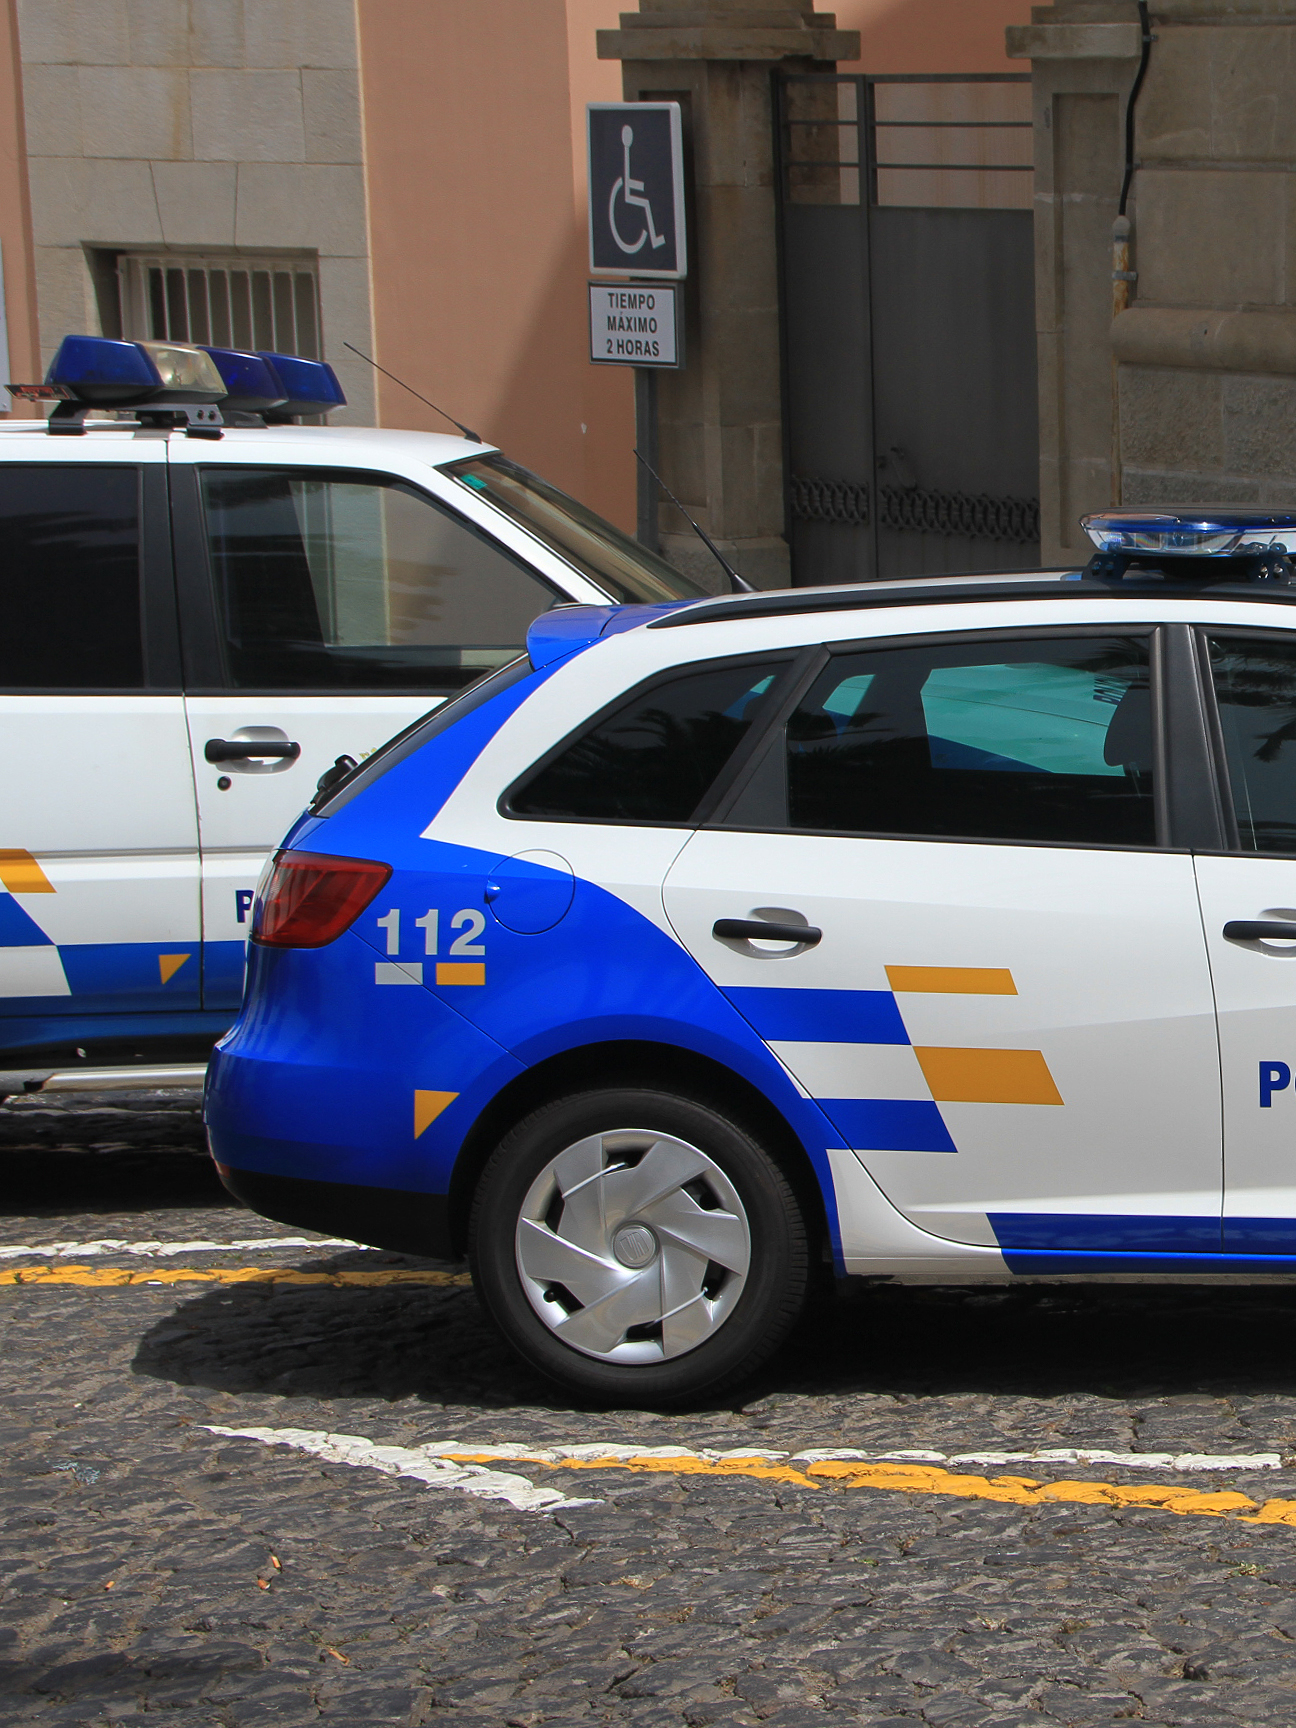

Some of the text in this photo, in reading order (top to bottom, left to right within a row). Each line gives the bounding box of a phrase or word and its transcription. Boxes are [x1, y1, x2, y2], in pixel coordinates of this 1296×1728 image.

[608, 292, 656, 310] TIEMPO
[607, 338, 660, 357] 2 HORAS
[377, 908, 486, 956] 112
